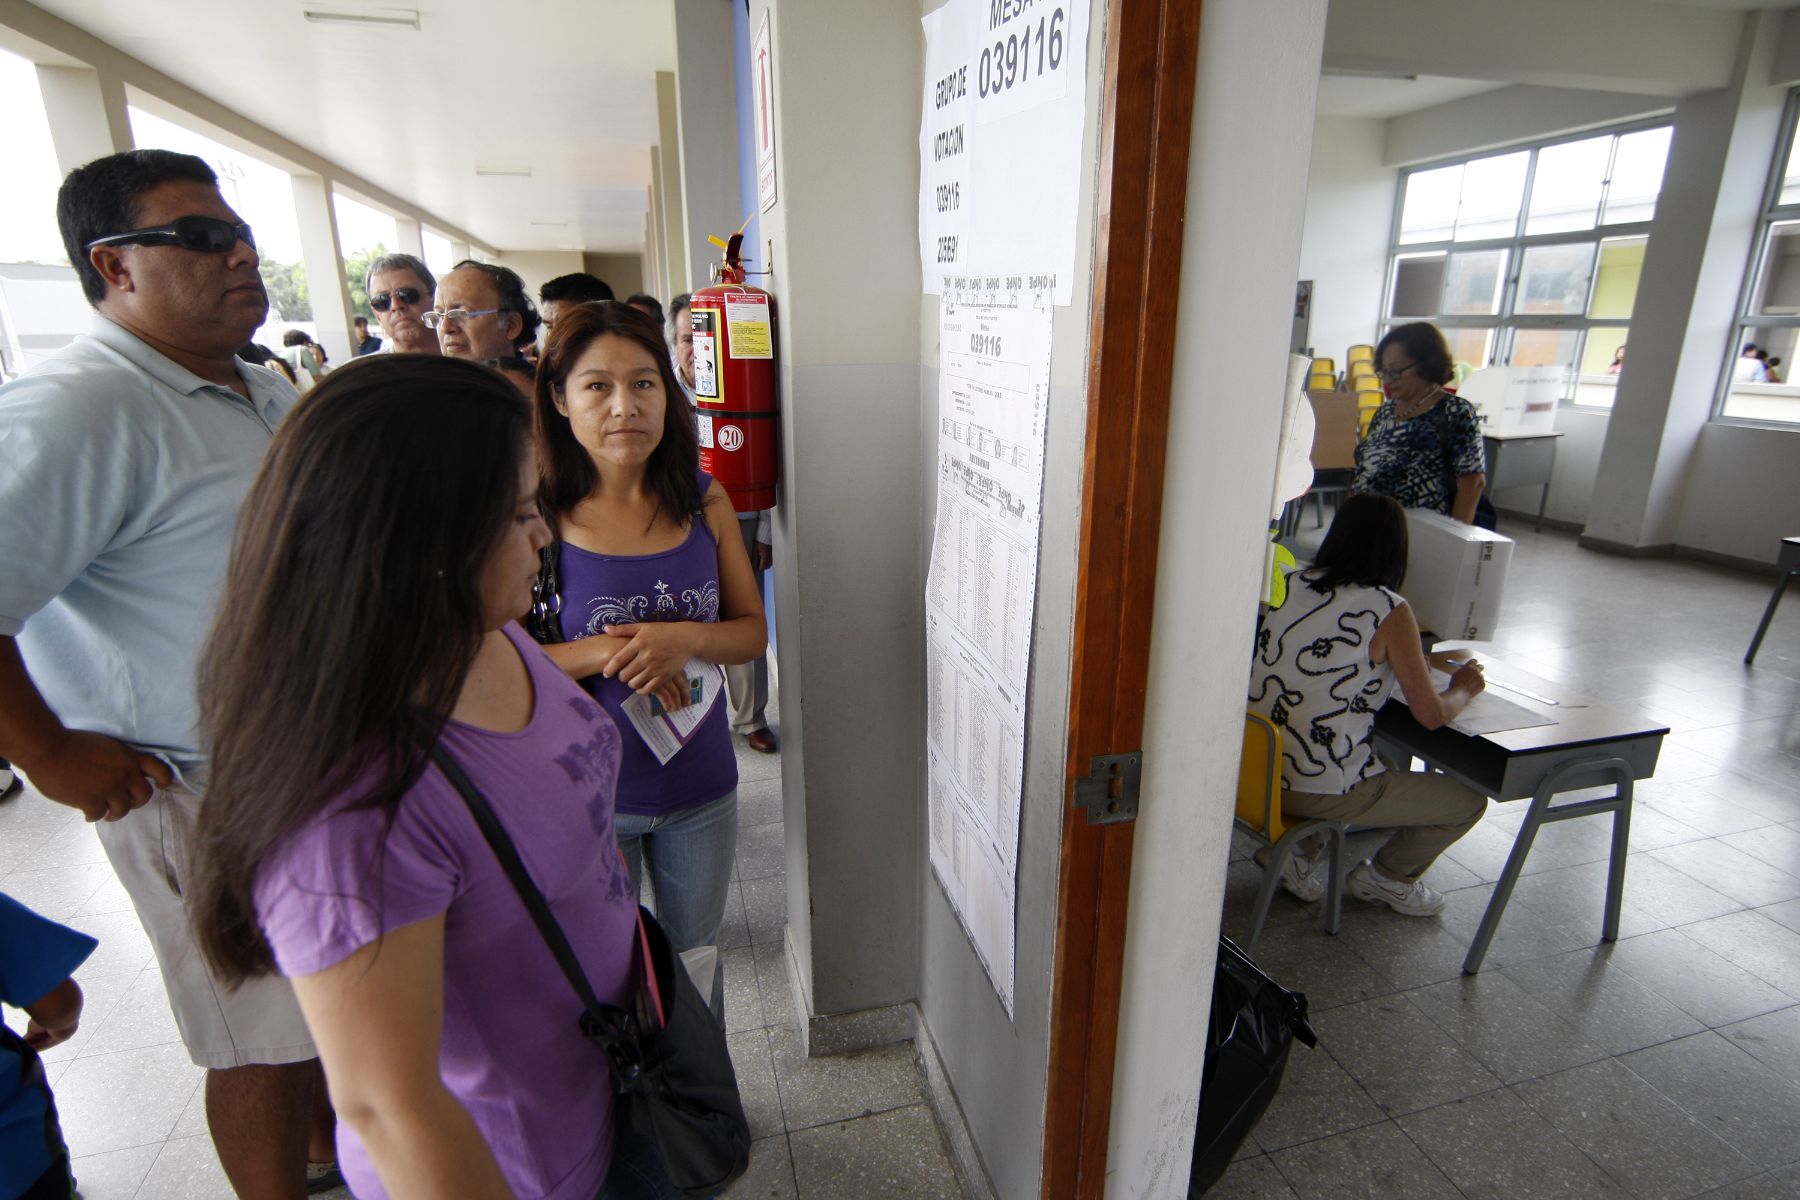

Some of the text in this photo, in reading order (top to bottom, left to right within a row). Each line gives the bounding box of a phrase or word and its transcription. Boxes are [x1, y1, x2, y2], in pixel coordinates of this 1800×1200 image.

[979, 7, 1064, 99] 039116
[935, 64, 967, 110] GRUPO DE
[934, 123, 964, 162] VOTACION
[936, 181, 960, 213] 039116
[970, 333, 1002, 357] 039116
[723, 429, 739, 446] 20
